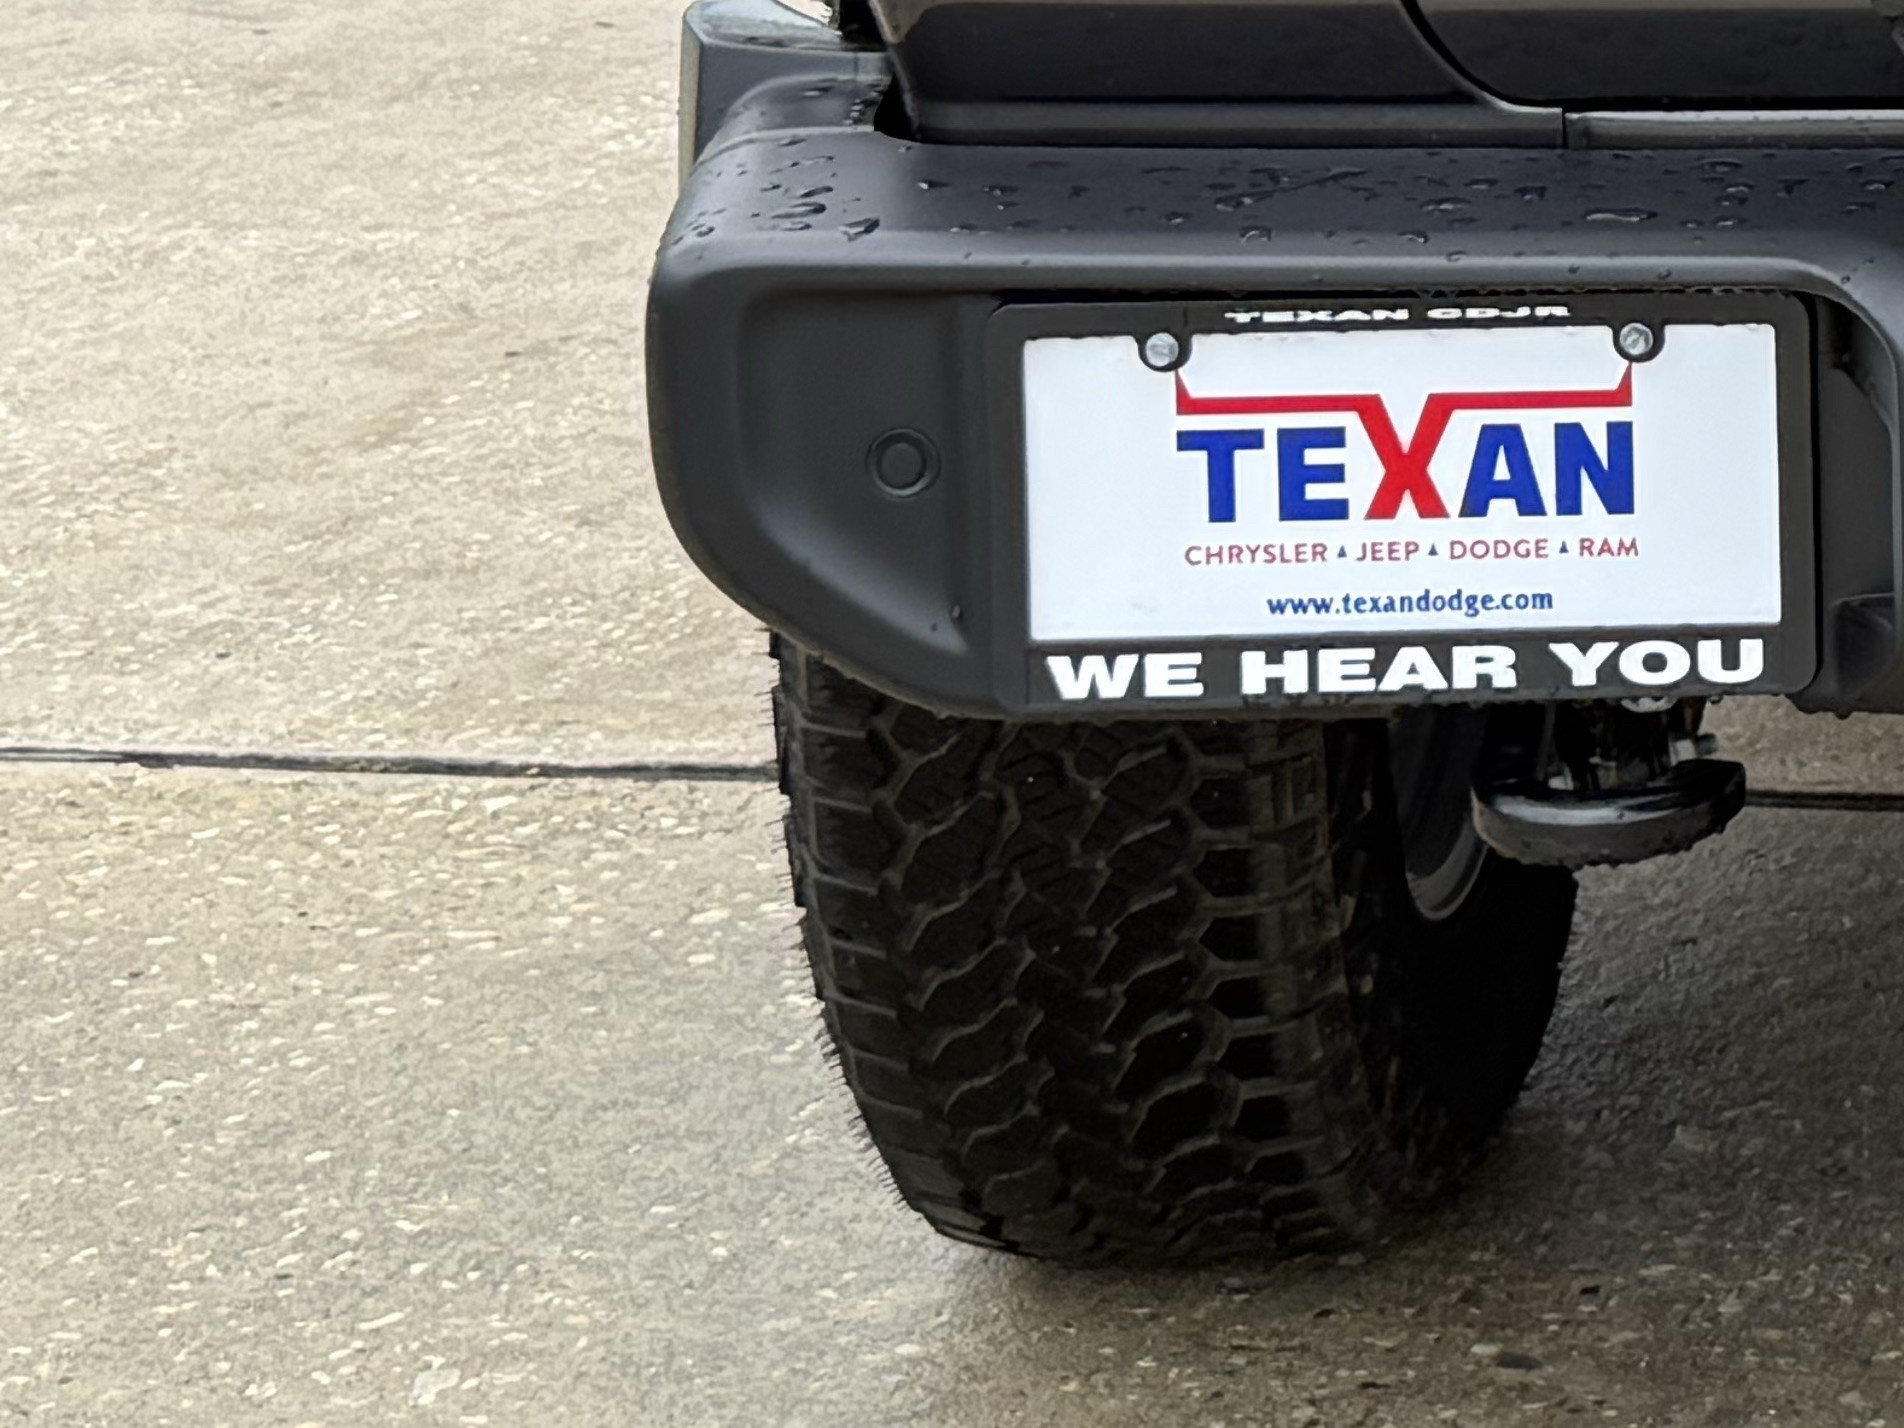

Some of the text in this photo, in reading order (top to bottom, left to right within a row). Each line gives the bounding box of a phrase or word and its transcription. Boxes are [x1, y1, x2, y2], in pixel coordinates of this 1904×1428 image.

[1224, 307, 1409, 324] TEXAN
[1176, 393, 1635, 523] TEXAN
[1185, 537, 1639, 566] CHRYSLER JEEP DODGE RAM
[1267, 589, 1553, 618] www.texandodge.com
[1046, 638, 1764, 700] WE HEAR YOU
